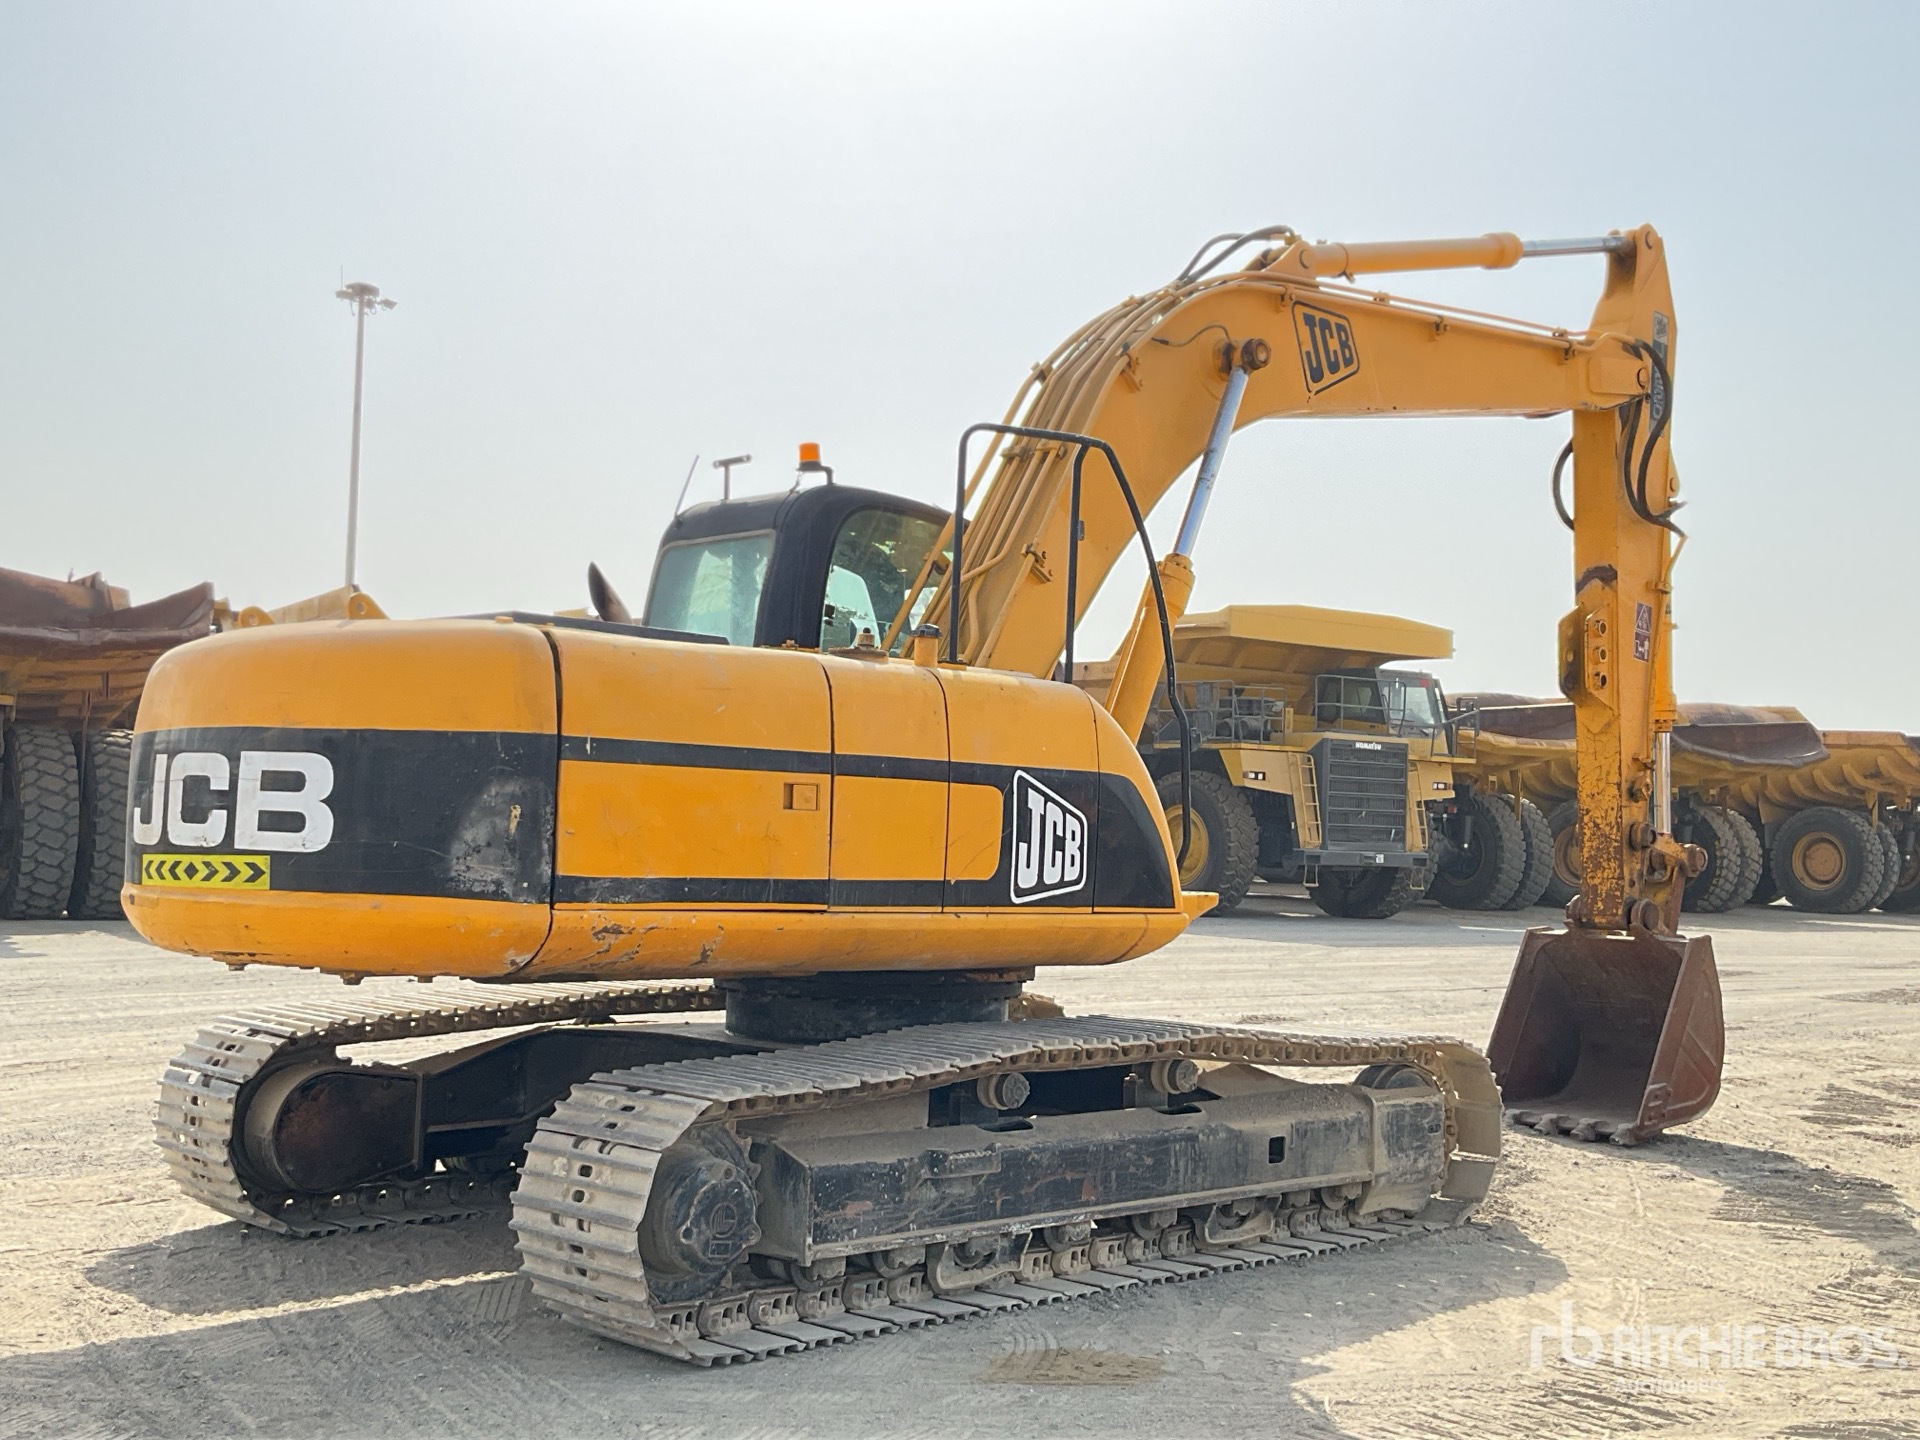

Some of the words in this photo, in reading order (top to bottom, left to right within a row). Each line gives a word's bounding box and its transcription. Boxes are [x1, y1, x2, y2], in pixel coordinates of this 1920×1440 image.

[1302, 311, 1355, 384] JCB
[1355, 741, 1382, 751] KOMATSU
[133, 750, 335, 853] JCB
[1017, 787, 1082, 889] JCB
